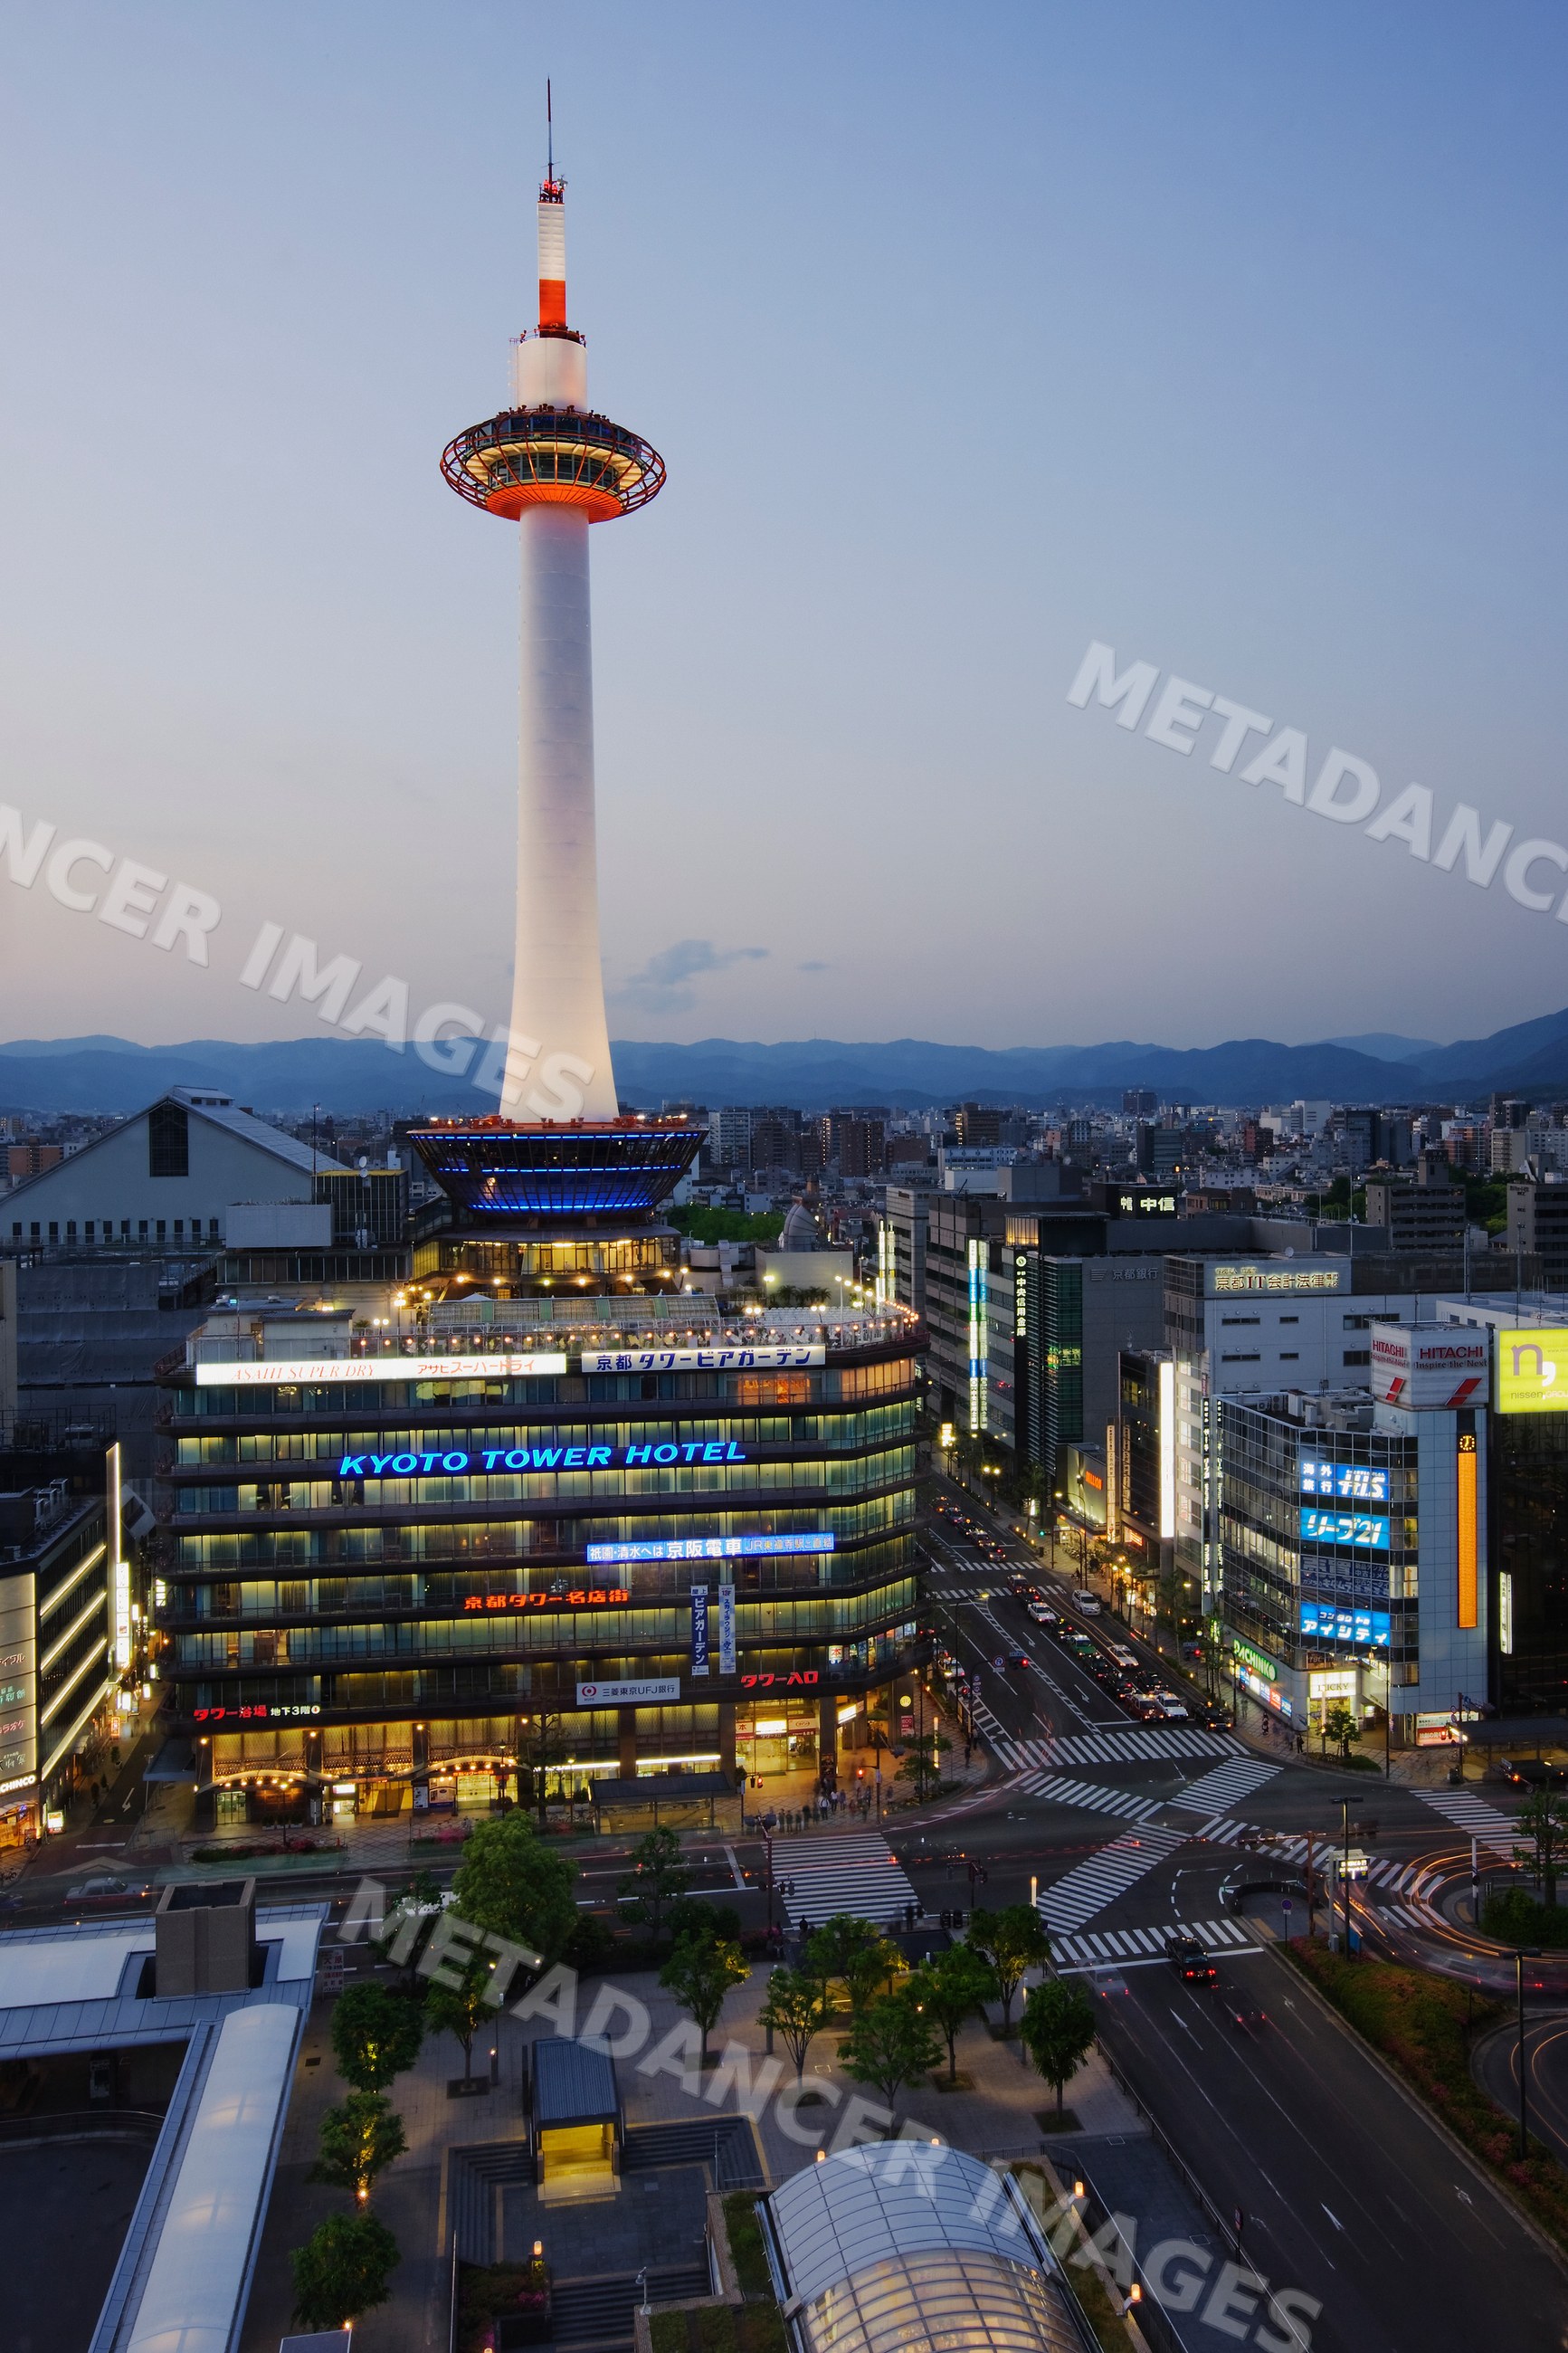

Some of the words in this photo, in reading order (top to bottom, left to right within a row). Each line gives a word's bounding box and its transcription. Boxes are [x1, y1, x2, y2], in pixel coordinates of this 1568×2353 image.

[1140, 1196, 1175, 1212] 中信
[1112, 1267, 1159, 1281] 京都銀行
[1373, 1339, 1404, 1358] HITACHI
[1420, 1346, 1484, 1359] HITACHI
[231, 1366, 283, 1382] ASAHI
[287, 1364, 340, 1380] SUPER
[345, 1363, 376, 1378] DRY
[1415, 1362, 1447, 1370] Inspire
[1449, 1360, 1463, 1368] the
[340, 1452, 470, 1476] KYOTO
[482, 1445, 613, 1470] TOWER
[624, 1441, 748, 1464] HOTEL
[1303, 1463, 1333, 1477] 海外
[1303, 1479, 1333, 1493] 旅行
[666, 1538, 743, 1558] 京阪電車
[463, 1588, 630, 1610] 京都タワー名店街
[694, 1597, 706, 1665] ビアガーデン
[1301, 1619, 1388, 1643] アイシティ
[740, 1671, 819, 1689] タワー入口
[602, 1684, 675, 1698] 三菱東京UFJ銀行
[193, 1704, 268, 1722] タワー浴場
